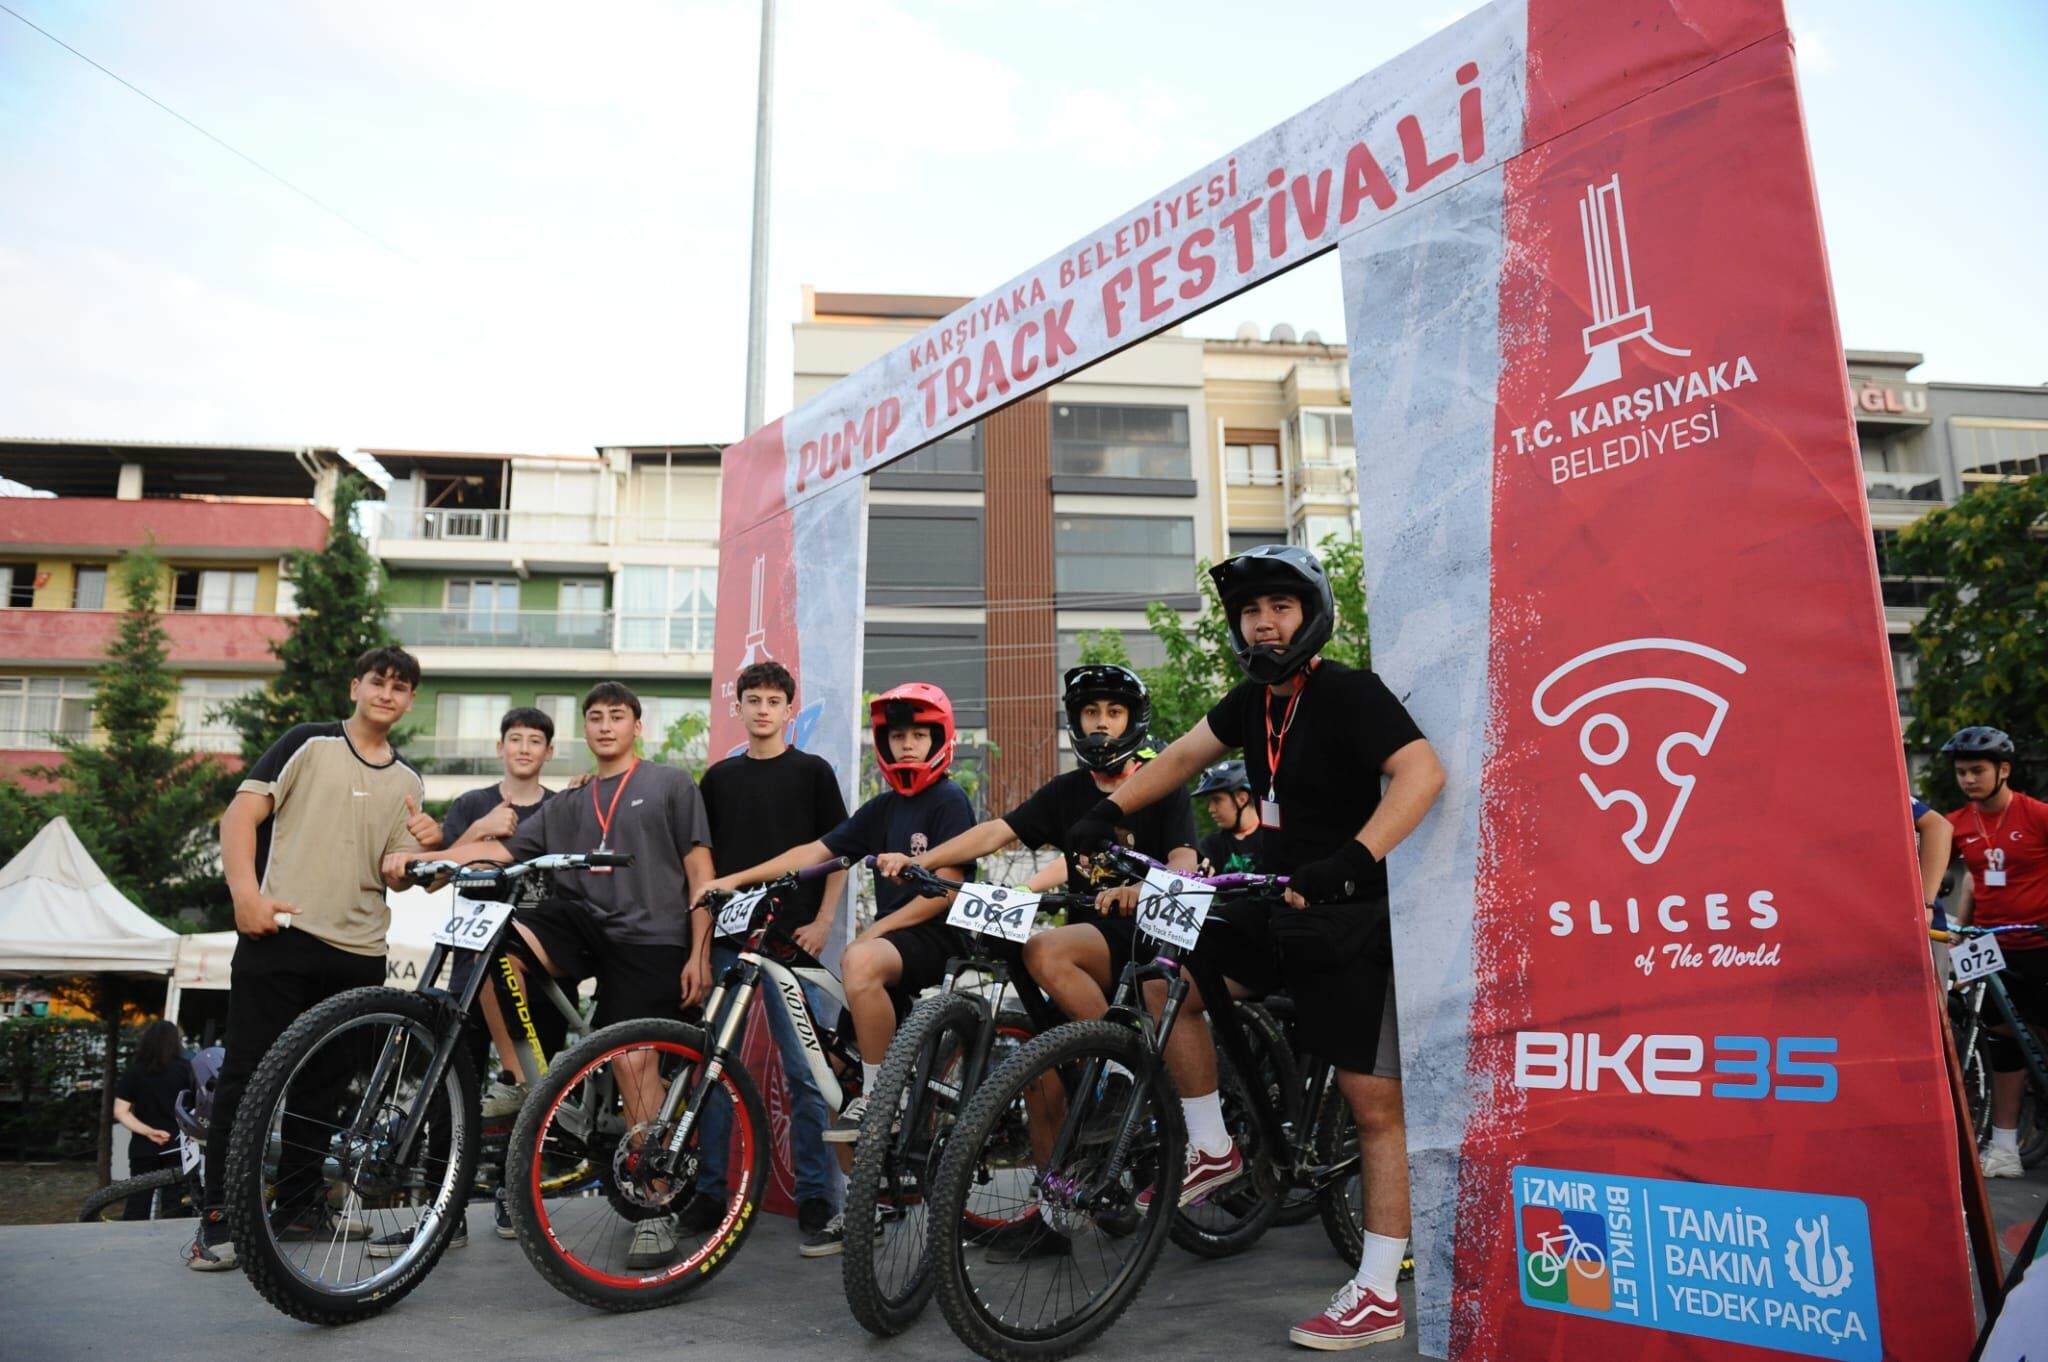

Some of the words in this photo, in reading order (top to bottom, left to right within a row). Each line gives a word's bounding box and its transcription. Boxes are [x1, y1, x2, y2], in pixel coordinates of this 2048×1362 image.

[796, 396, 901, 493] PUMP
[917, 298, 1078, 428] TRACK
[1101, 61, 1486, 339] FESTİVALİ
[909, 277, 1047, 372] KARŞIYAKA
[1059, 157, 1238, 289] BELEDİYESİ
[1510, 419, 1563, 456] T.C.
[1569, 354, 1759, 438] KARŞIYAKA
[1853, 382, 1928, 413] ĞLU
[1550, 403, 1720, 486] BELEDİYESİ
[444, 916, 494, 938] 015
[963, 898, 1025, 929] 064
[1145, 893, 1197, 933] 044
[1548, 889, 1779, 937] SLICES
[1633, 945, 1656, 977] of
[1662, 943, 1704, 969] The
[1707, 942, 1782, 968] World
[1960, 948, 1998, 973] 072
[700, 1200, 753, 1274] MAXXIS
[1658, 1204, 1771, 1250] TAMİR
[1664, 1243, 1775, 1290] BAKIM
[1666, 1283, 1761, 1325] YEDEK
[1763, 1298, 1869, 1345] PARÇA
